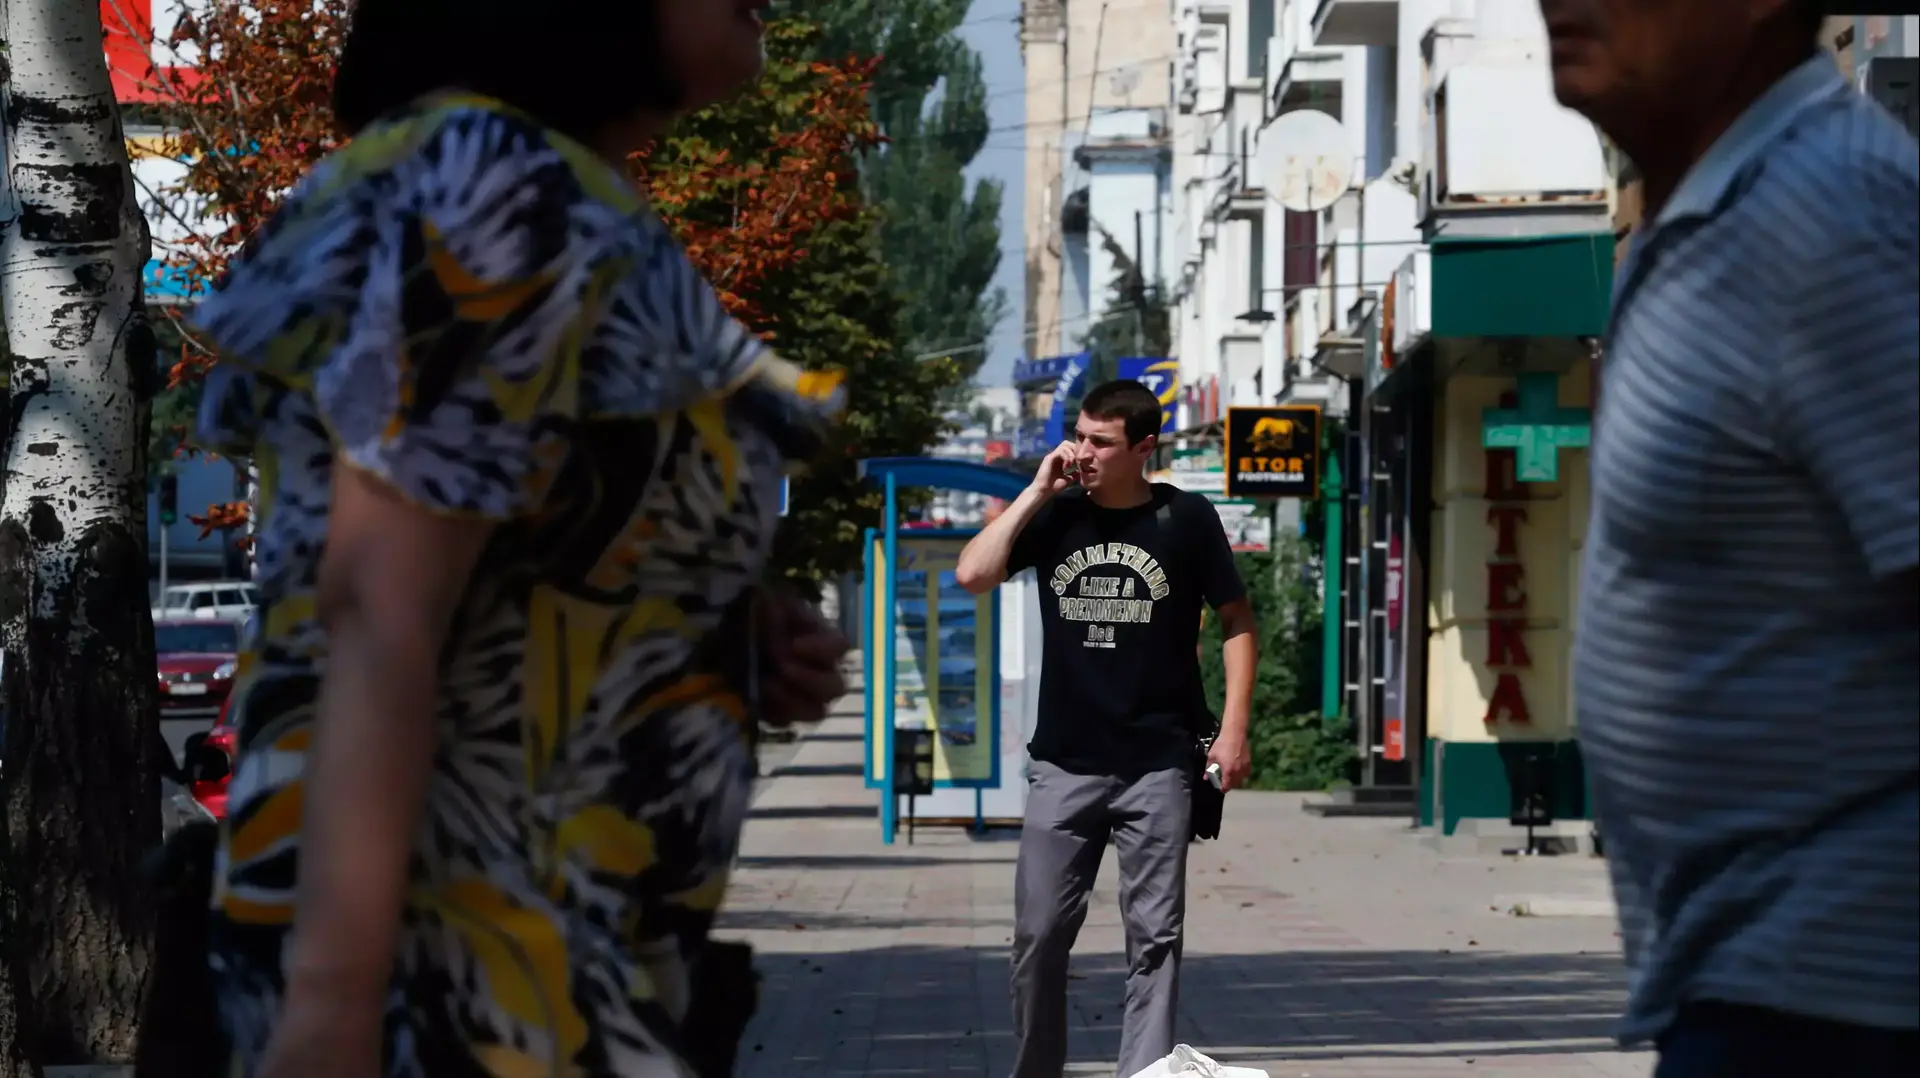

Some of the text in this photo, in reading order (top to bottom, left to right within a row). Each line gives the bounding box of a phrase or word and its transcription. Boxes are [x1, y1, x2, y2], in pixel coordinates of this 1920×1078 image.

[1238, 457, 1304, 473] ETOR
[1236, 472, 1305, 482] FOOTWEAR
[1484, 392, 1533, 724] ПТЕКА
[1050, 542, 1170, 601] SOMMETHING
[1079, 576, 1135, 597] LIKE A
[1088, 624, 1115, 642] D&G
